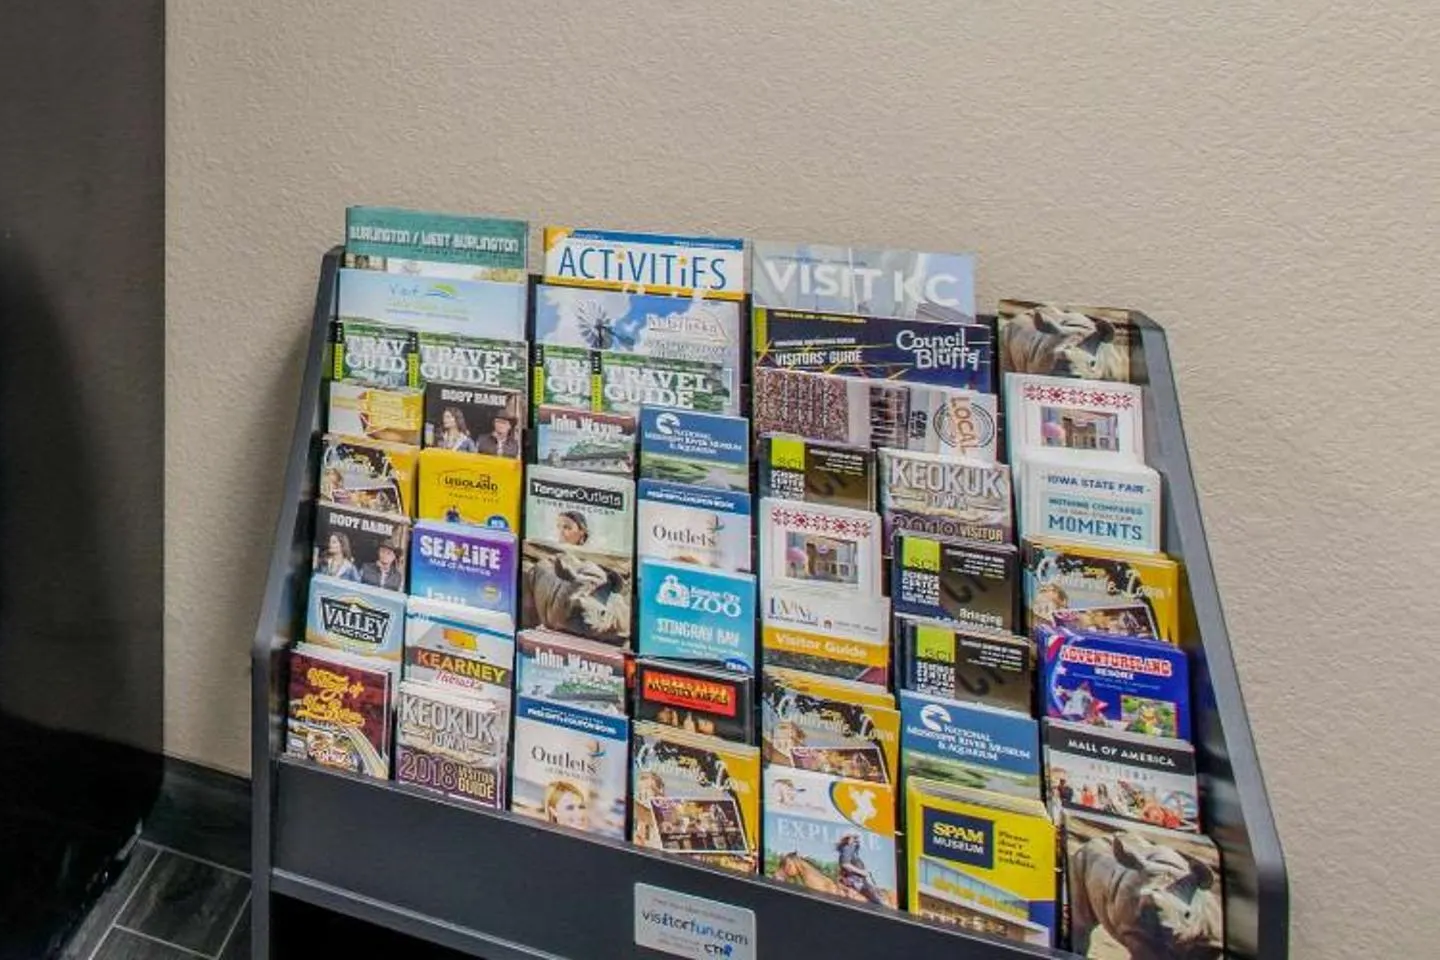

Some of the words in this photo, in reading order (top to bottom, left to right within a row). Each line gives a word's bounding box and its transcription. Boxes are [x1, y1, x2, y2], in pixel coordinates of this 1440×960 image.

[453, 235, 519, 253] BURLINGTON
[764, 260, 882, 303] VISIT
[893, 268, 960, 307] KC
[346, 335, 405, 356] TRAV
[895, 328, 966, 352] Council
[346, 353, 407, 374] GUID
[420, 345, 518, 371] TRAVEL
[828, 350, 864, 364] GUIDE
[913, 346, 981, 372] Bluffs
[420, 362, 500, 387] GUIDE
[603, 365, 712, 392] TRAVEL
[603, 385, 694, 409] GUIDE
[891, 455, 1002, 499] KEOKUK
[1048, 475, 1078, 486] IOWA
[652, 523, 718, 547] Outlets
[1048, 514, 1142, 541] MOMENTS
[420, 534, 455, 559] SEA
[691, 595, 742, 618] ZOO
[324, 603, 388, 639] VALLEY
[417, 649, 505, 683] KEARNEY
[532, 645, 564, 669] John
[402, 694, 495, 743] KEOKUK
[531, 744, 597, 775] Outlets
[1068, 739, 1097, 753] MALL
[1102, 744, 1118, 757] OF
[1121, 750, 1176, 767] AMERICA
[398, 748, 456, 791] 2018
[458, 776, 496, 800] GUIDE
[932, 821, 985, 844] SPAM
[932, 836, 985, 855] MUSEUM
[642, 908, 748, 946] visitorfun.com
